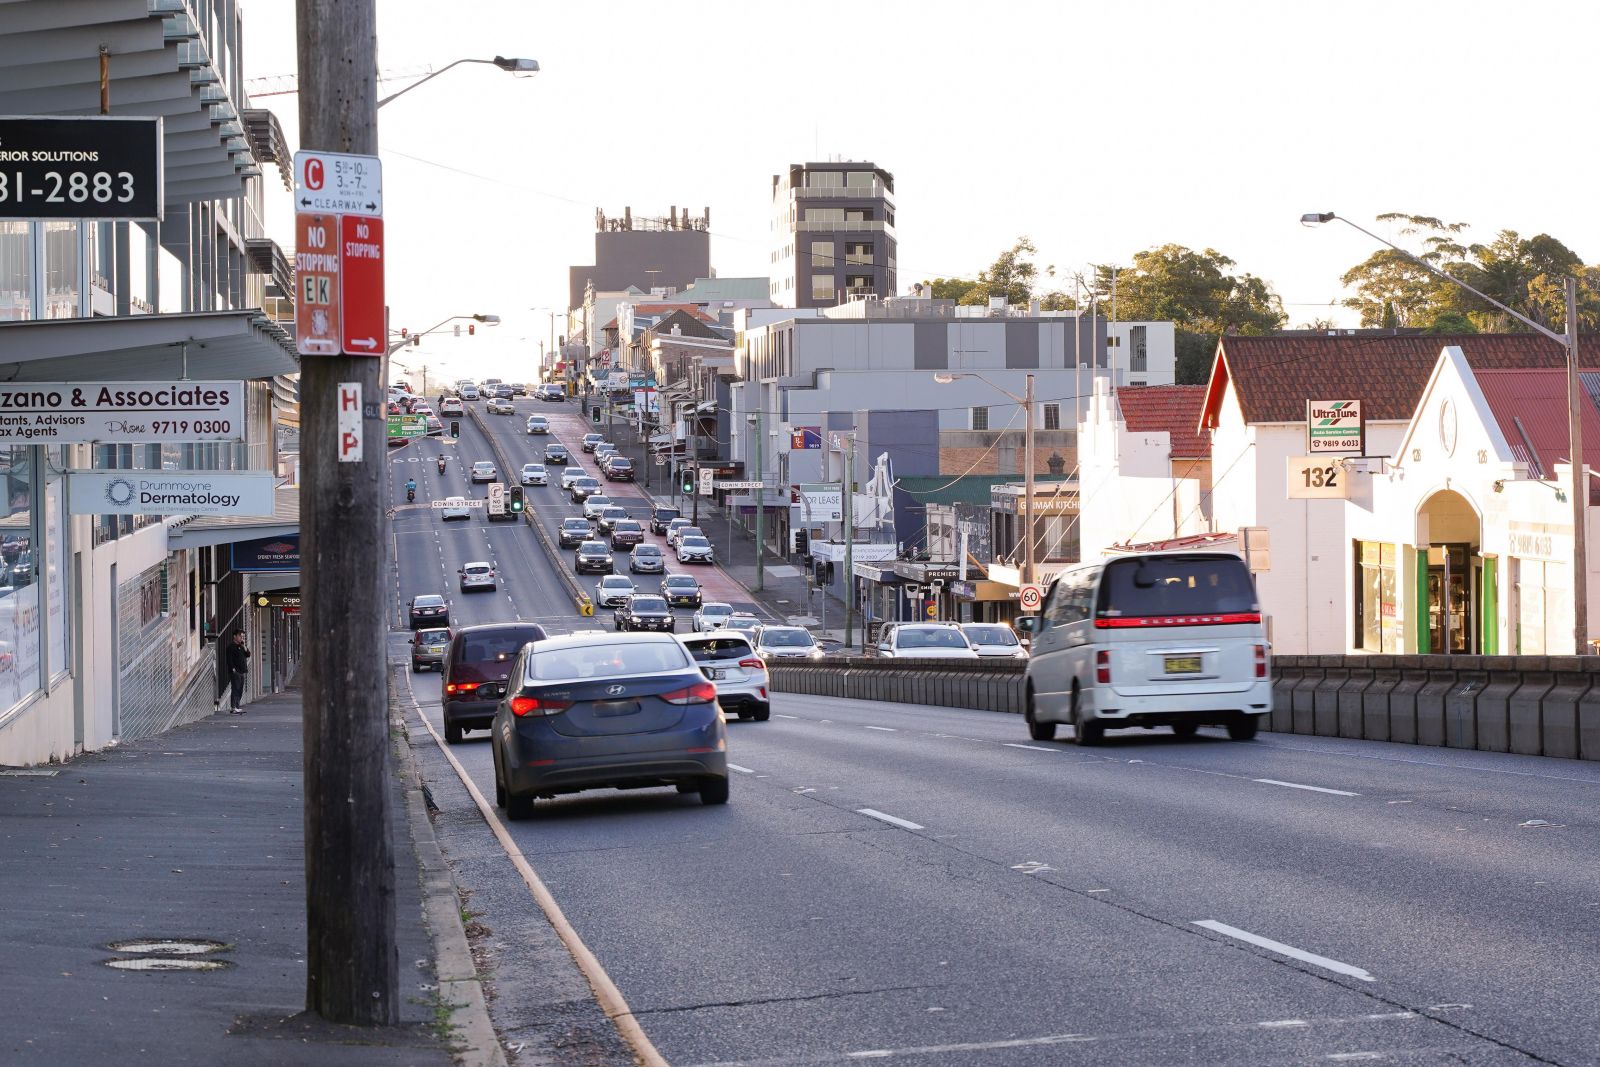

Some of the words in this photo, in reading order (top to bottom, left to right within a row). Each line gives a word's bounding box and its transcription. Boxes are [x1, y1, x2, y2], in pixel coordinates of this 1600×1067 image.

[32, 151, 99, 162] SOLUTIONS
[308, 158, 320, 188] C
[314, 198, 362, 211] CLEARWAY
[308, 226, 326, 248] NO
[356, 224, 370, 239] NO
[346, 242, 381, 260] STOPPING
[297, 252, 338, 273] STOPPING
[71, 388, 87, 407] &
[96, 386, 230, 407] Associates
[341, 389, 358, 411] H
[35, 414, 85, 425] Advisors
[15, 426, 58, 438] Agents
[104, 420, 147, 435] Phone
[152, 420, 188, 434] 9719
[193, 420, 231, 434] 0300
[343, 432, 359, 456] P
[1341, 439, 1359, 447] 6033
[1301, 467, 1338, 488] 132
[140, 480, 212, 492] Drummoyne
[140, 492, 240, 507] Dermatology
[818, 496, 840, 504] LEASE
[1023, 592, 1038, 602] 60
